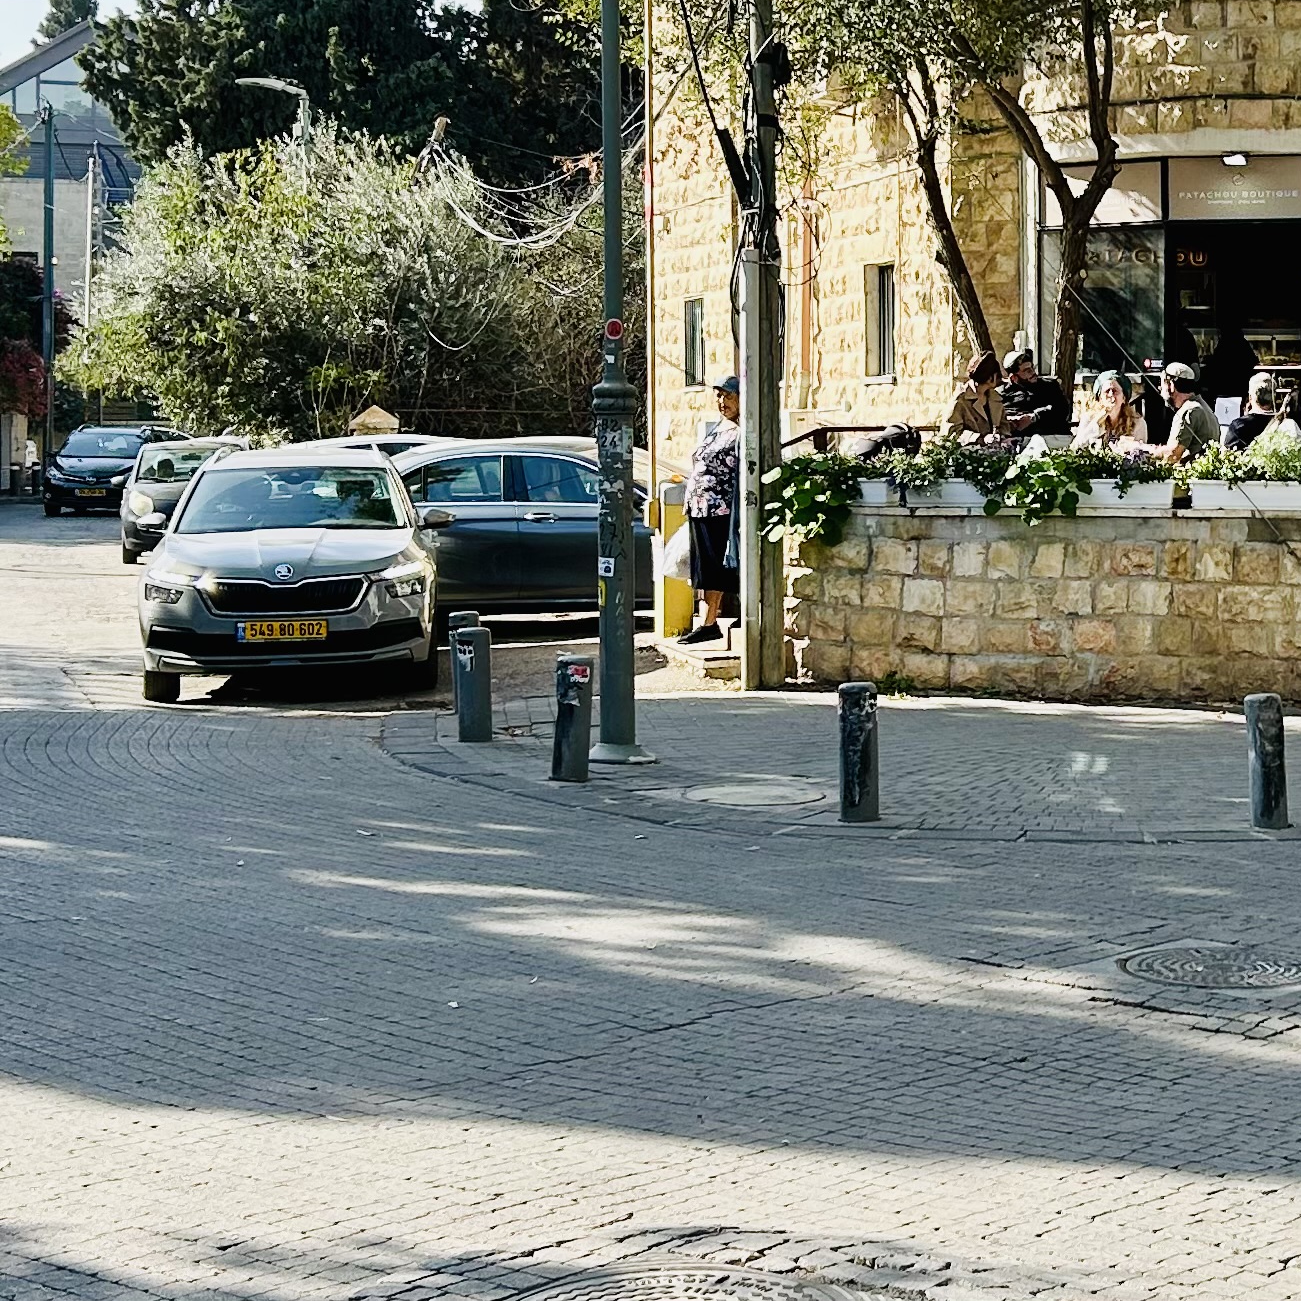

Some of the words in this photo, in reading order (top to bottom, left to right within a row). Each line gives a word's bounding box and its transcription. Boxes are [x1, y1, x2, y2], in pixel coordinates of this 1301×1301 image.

[1178, 190, 1238, 200] PATACHOU
[1241, 190, 1299, 199] BOUTIQUE
[249, 623, 274, 637] 549
[279, 622, 295, 636] 80
[299, 621, 323, 636] 602
